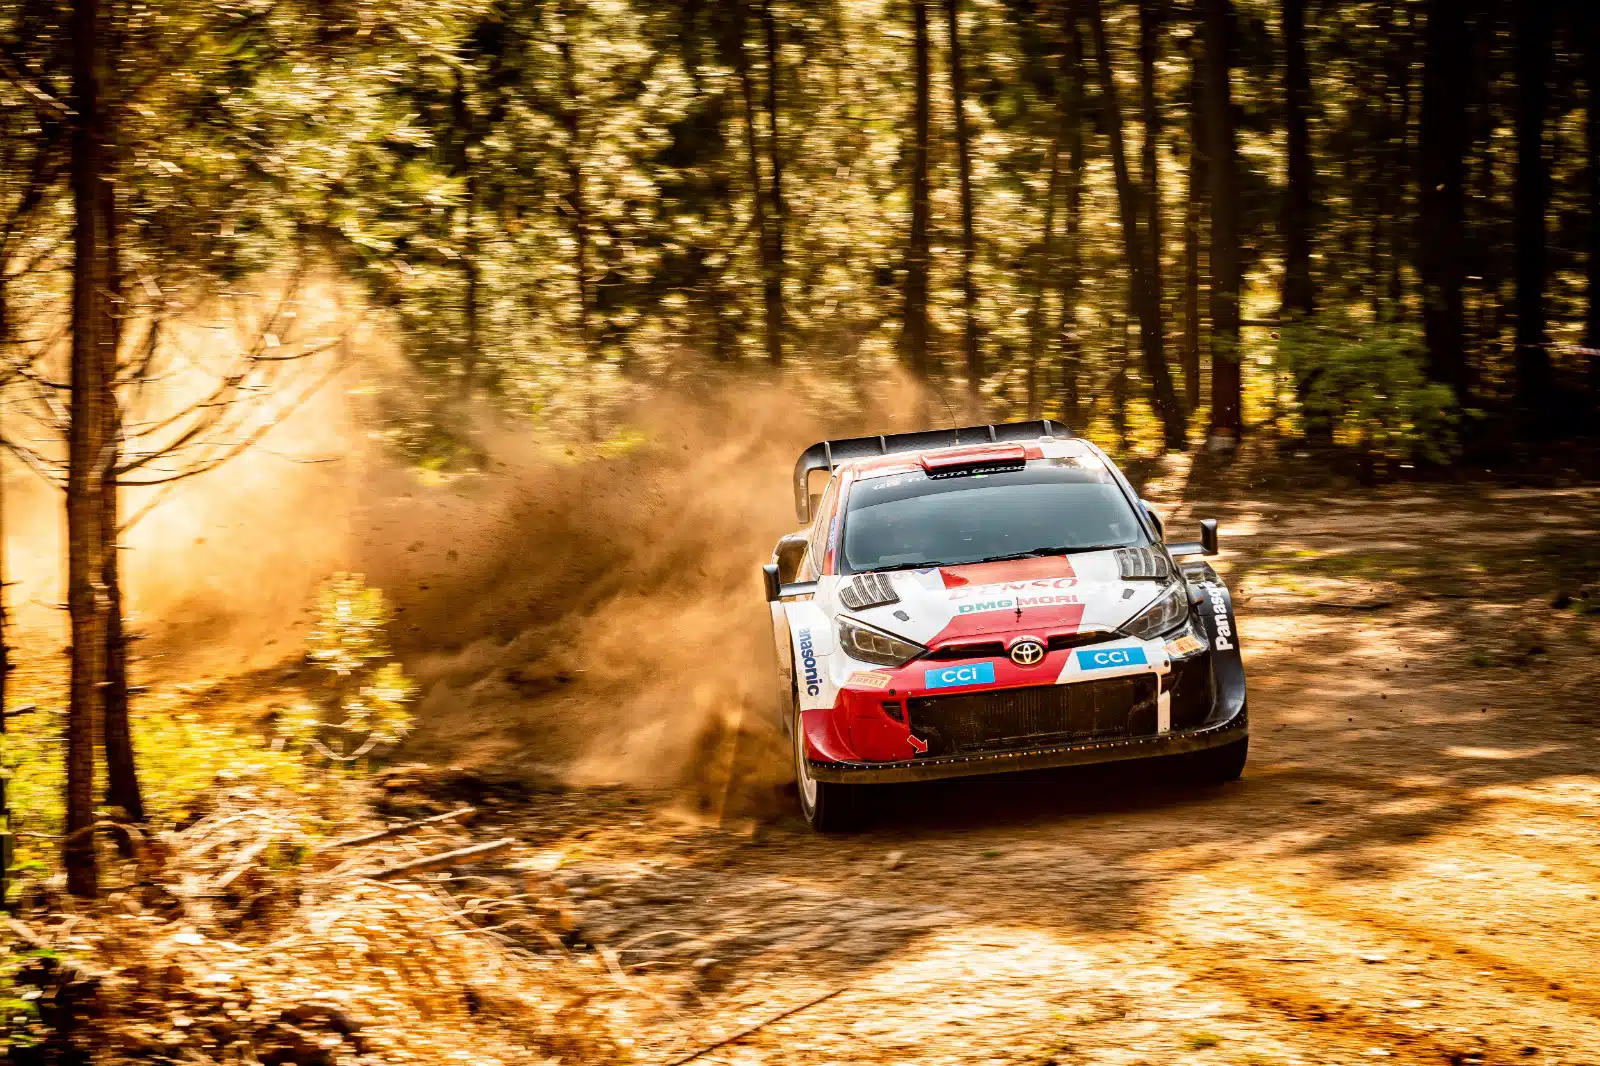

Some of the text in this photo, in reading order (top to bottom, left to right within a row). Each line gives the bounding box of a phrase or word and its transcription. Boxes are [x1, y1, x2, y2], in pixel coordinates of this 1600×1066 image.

[958, 595, 1078, 613] DMG MORI
[799, 627, 823, 697] anasonic
